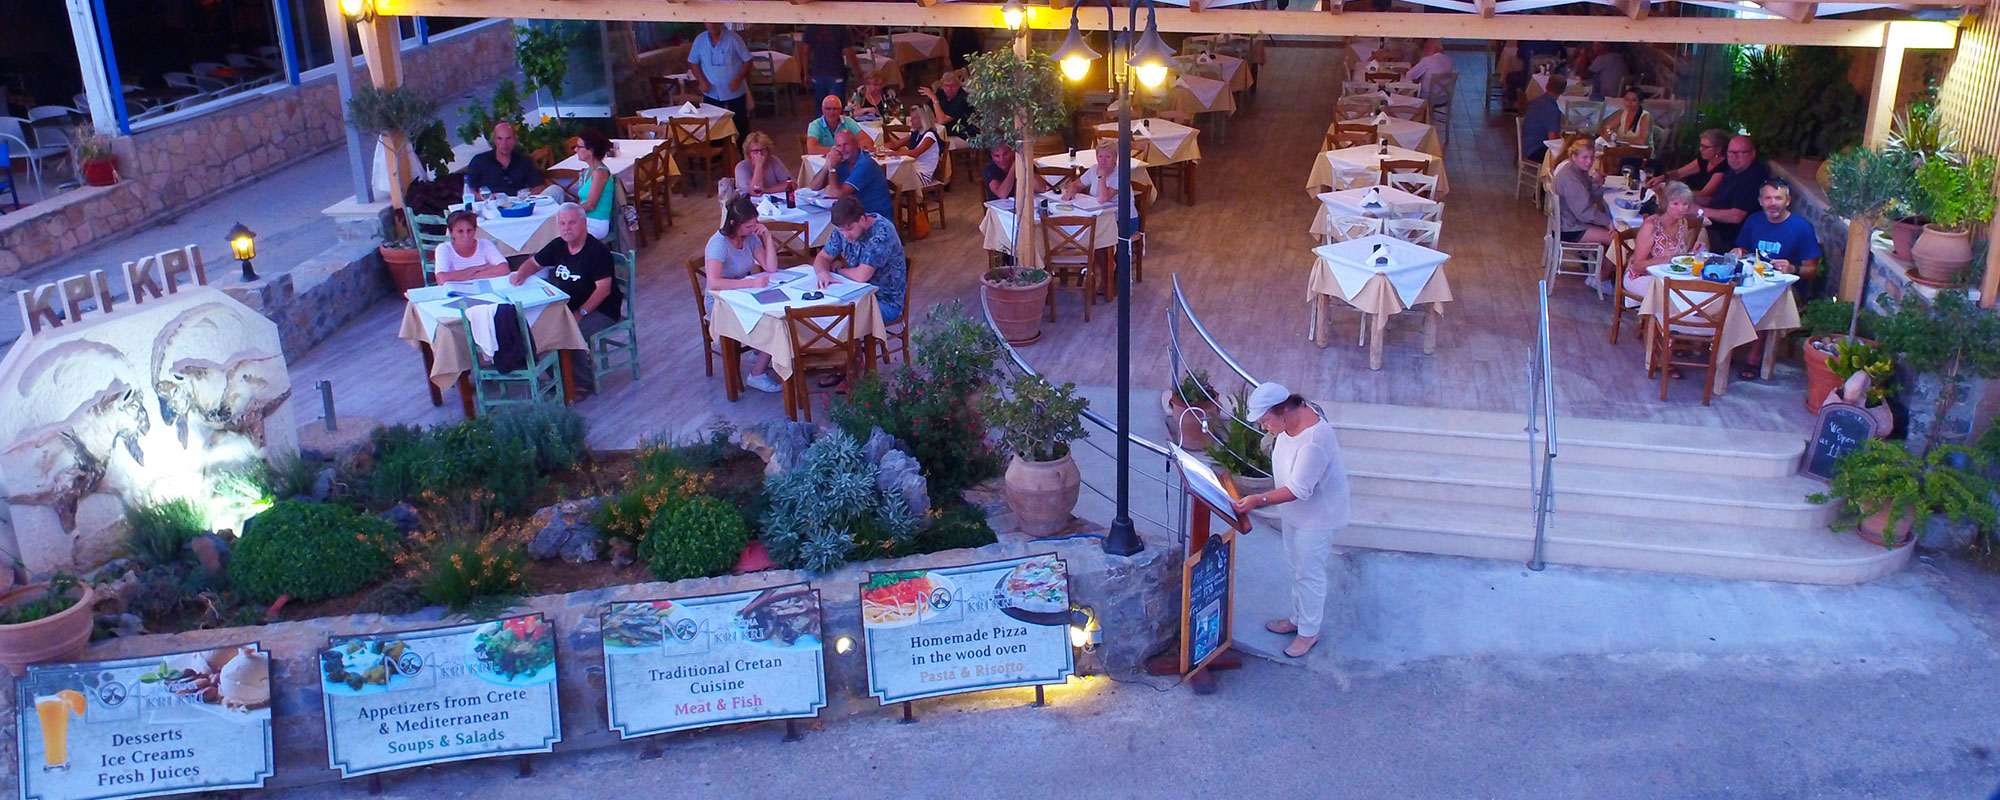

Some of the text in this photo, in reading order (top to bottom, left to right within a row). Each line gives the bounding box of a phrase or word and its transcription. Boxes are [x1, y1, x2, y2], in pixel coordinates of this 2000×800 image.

[910, 626, 1028, 648] Homemade Pizza
[911, 642, 1027, 665] in the wood oven
[649, 657, 782, 682] Traditional Cretan
[920, 661, 1024, 683] Pasta & Risotto
[690, 679, 745, 694] Cuisine
[358, 690, 527, 720] Appetizers from Crete
[675, 694, 763, 716] Meat & Fish
[379, 711, 509, 735] & Mediterranean
[112, 729, 183, 747] Desserts
[388, 728, 505, 754] Soups & Salads
[101, 748, 195, 767] Ice Creams
[98, 764, 200, 786] Fresh Juices
